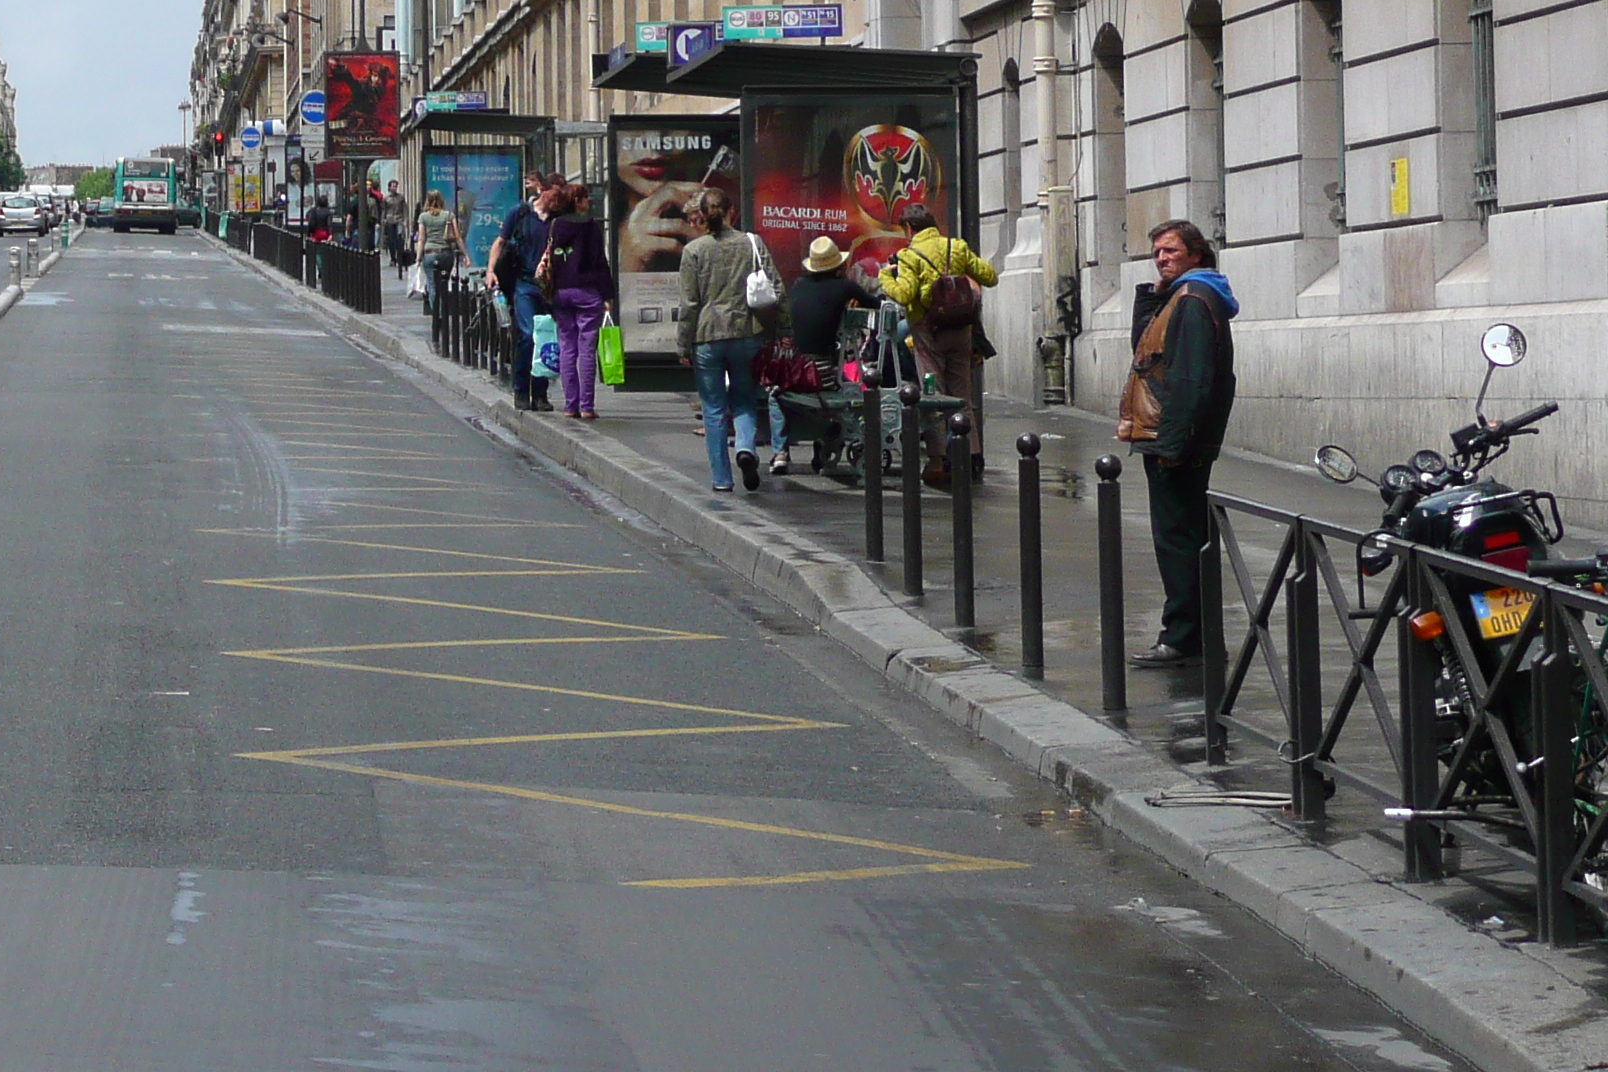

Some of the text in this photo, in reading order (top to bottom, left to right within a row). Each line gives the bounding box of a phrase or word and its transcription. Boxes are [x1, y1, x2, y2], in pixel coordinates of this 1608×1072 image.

[749, 12, 761, 21] 80
[767, 11, 779, 20] 95
[622, 135, 712, 150] SAMSUNG
[763, 206, 847, 220] BACARDI RUM
[762, 219, 847, 232] ORIGINAL SINCE 1862
